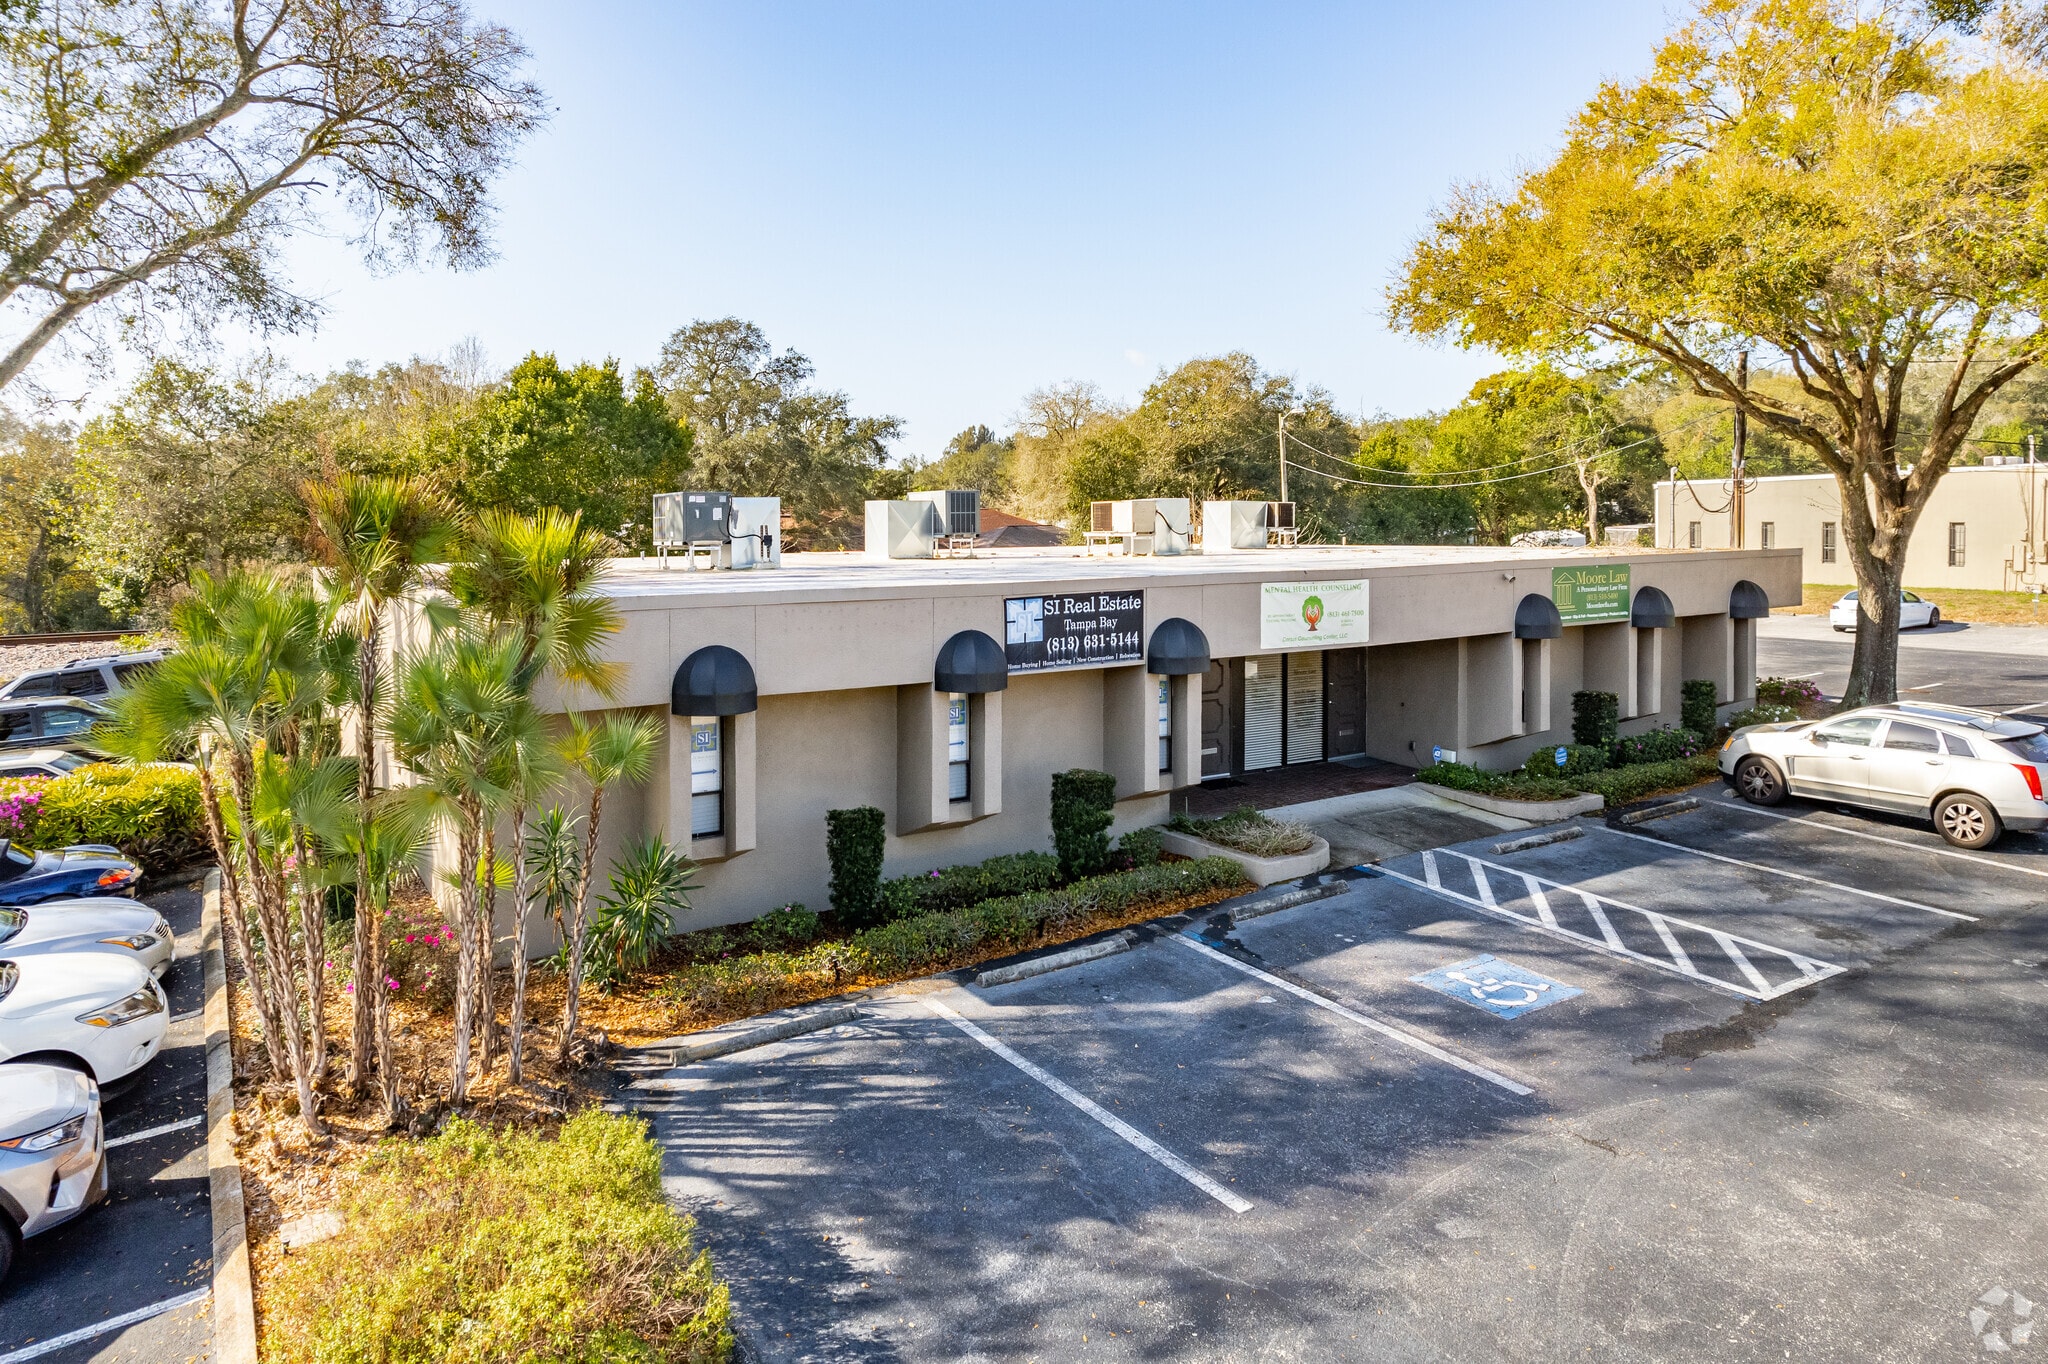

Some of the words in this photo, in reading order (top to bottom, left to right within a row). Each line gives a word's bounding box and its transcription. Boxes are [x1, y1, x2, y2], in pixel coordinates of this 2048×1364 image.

[1576, 571, 1607, 585] Moore
[1609, 570, 1628, 583] Law
[1265, 586, 1291, 594] MENTAL
[1293, 585, 1318, 593] HEALTH
[1321, 583, 1362, 592] COUNSELING
[1581, 585, 1597, 593] Personal
[1598, 584, 1609, 592] Injury
[1043, 599, 1061, 616] SI
[1063, 596, 1096, 614] Real
[1098, 594, 1142, 613] Estate
[1064, 617, 1097, 632] Tampa
[1099, 616, 1118, 629] Bay
[1046, 635, 1080, 654] (813)
[1083, 631, 1139, 648] 631-5144
[949, 708, 958, 718] SI
[697, 732, 709, 743] SI
